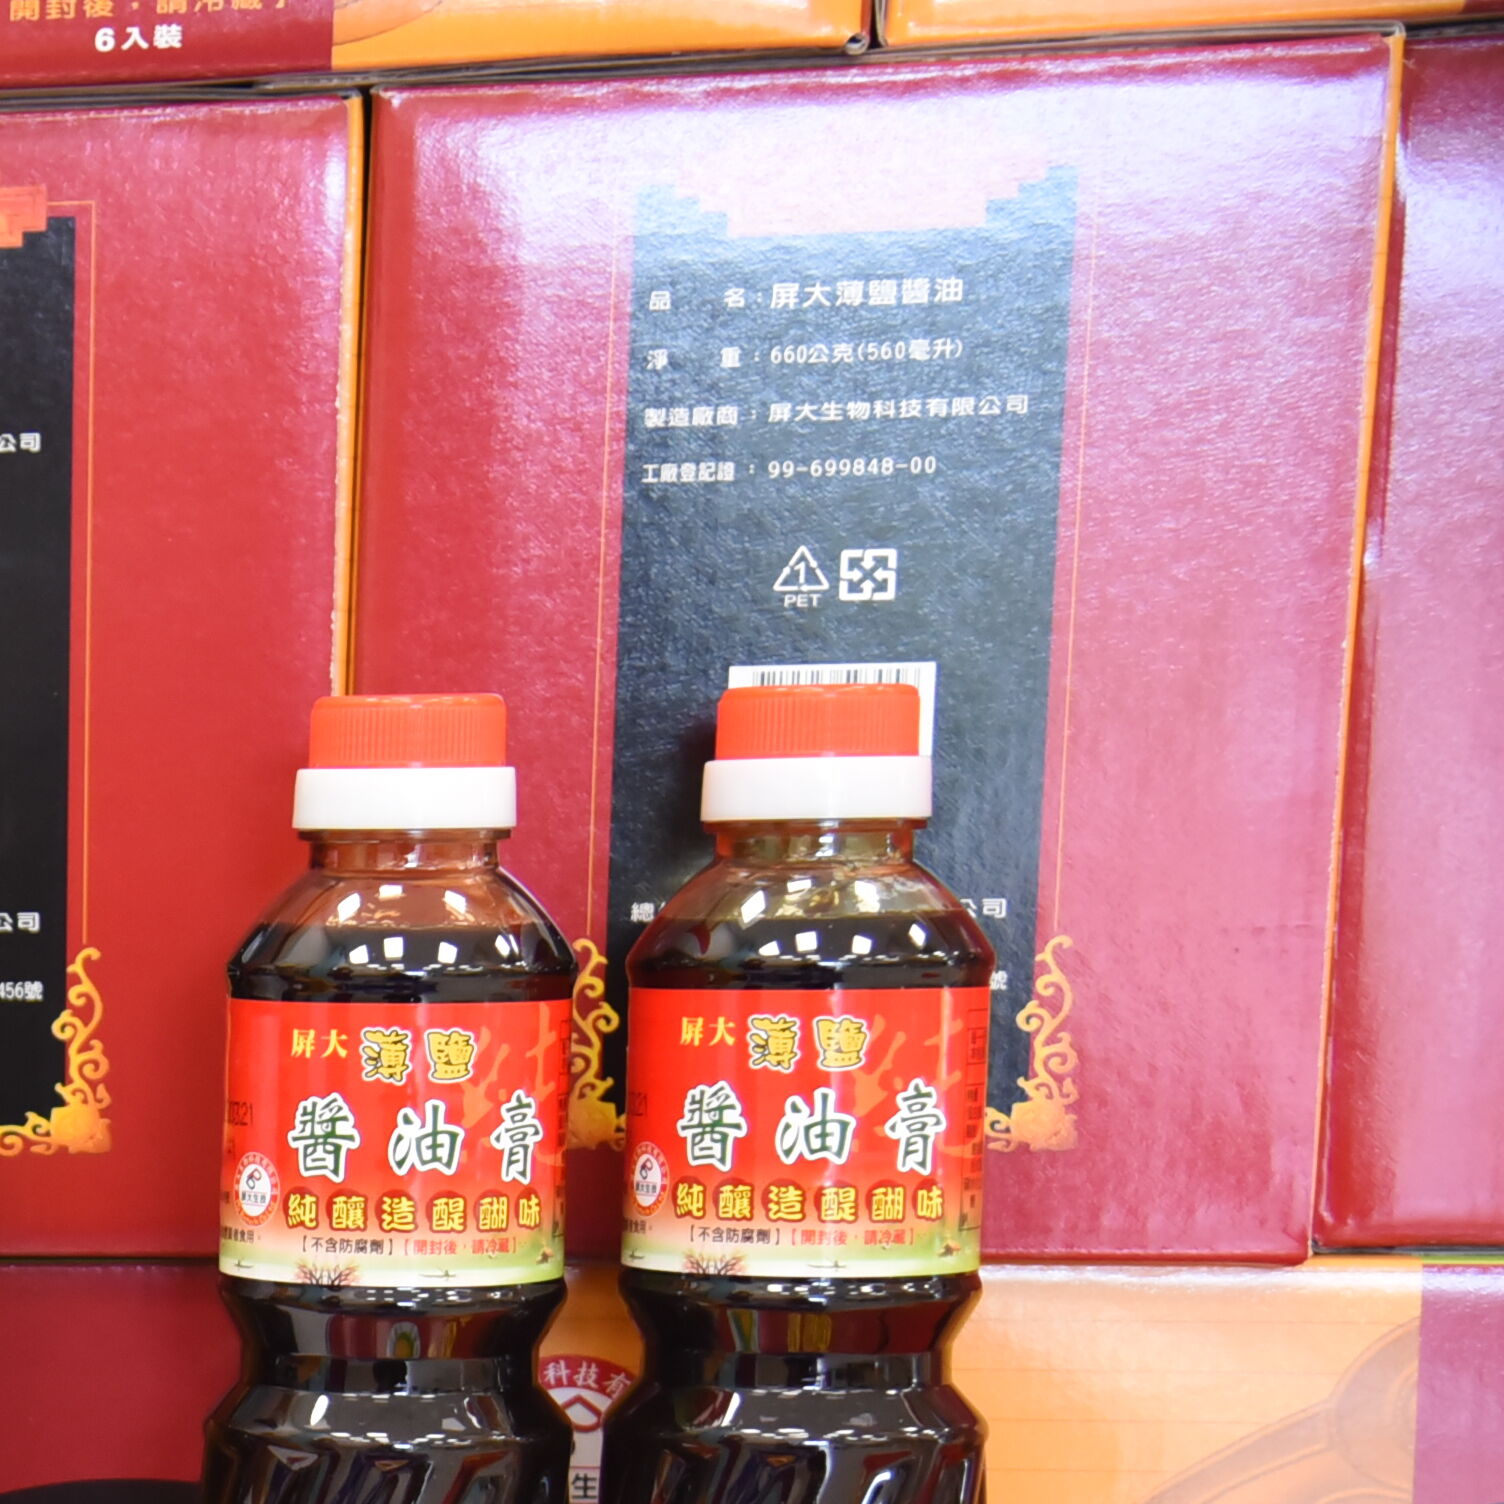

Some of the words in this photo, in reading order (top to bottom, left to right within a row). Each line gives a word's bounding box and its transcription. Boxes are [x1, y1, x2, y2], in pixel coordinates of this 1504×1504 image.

[93, 23, 183, 52] 6入裝
[783, 594, 820, 608] PET
[288, 1092, 544, 1182] 醬油膏
[677, 1082, 944, 1173] 醬油膏
